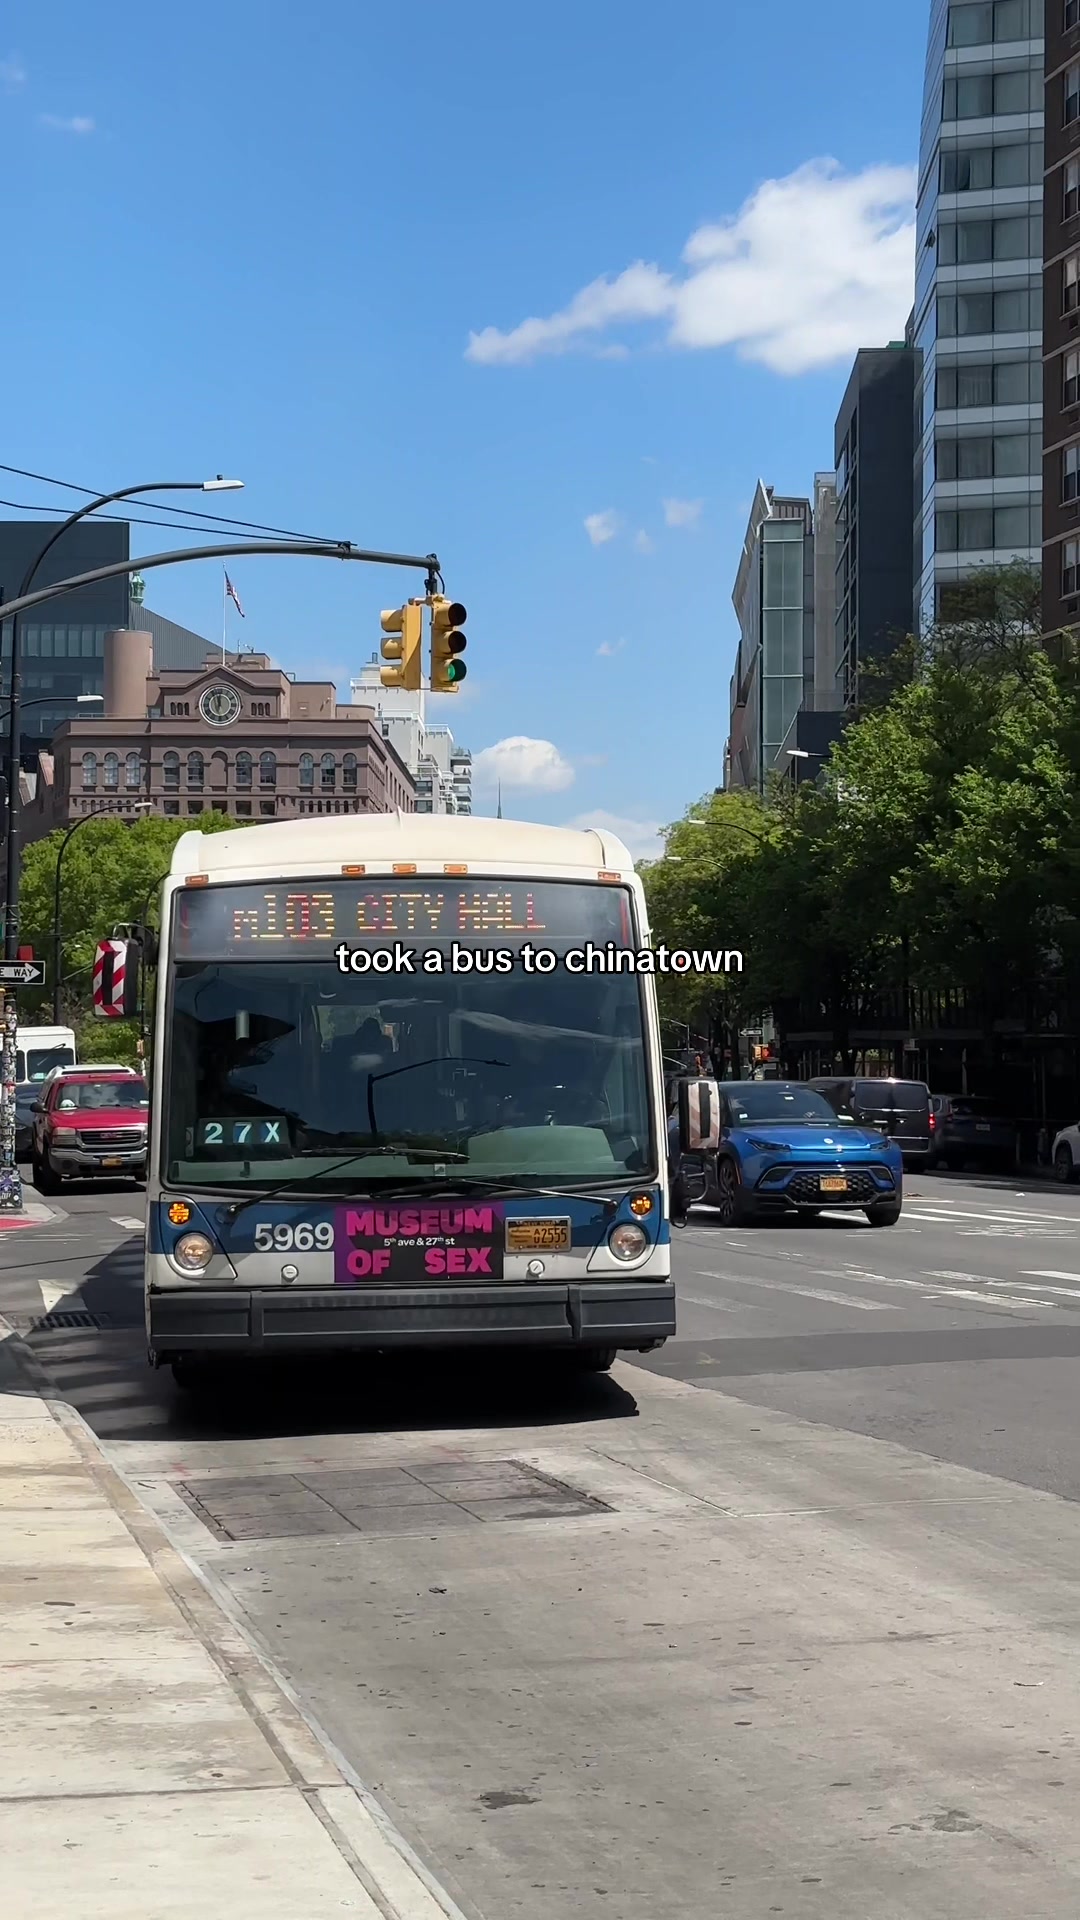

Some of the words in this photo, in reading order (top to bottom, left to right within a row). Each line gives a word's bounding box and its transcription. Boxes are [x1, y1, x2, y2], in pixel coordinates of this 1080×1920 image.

[357, 893, 444, 930] CITY
[458, 892, 546, 930] HALL
[13, 968, 34, 977] WAY
[253, 1222, 335, 1252] 5969
[346, 1207, 493, 1237] MUSEUM
[384, 1237, 397, 1247] 5th
[397, 1238, 416, 1247] ave
[416, 1237, 425, 1246] &
[425, 1236, 445, 1246] 27th
[445, 1236, 456, 1246] st
[346, 1249, 392, 1277] OF
[424, 1246, 493, 1275] SEX
